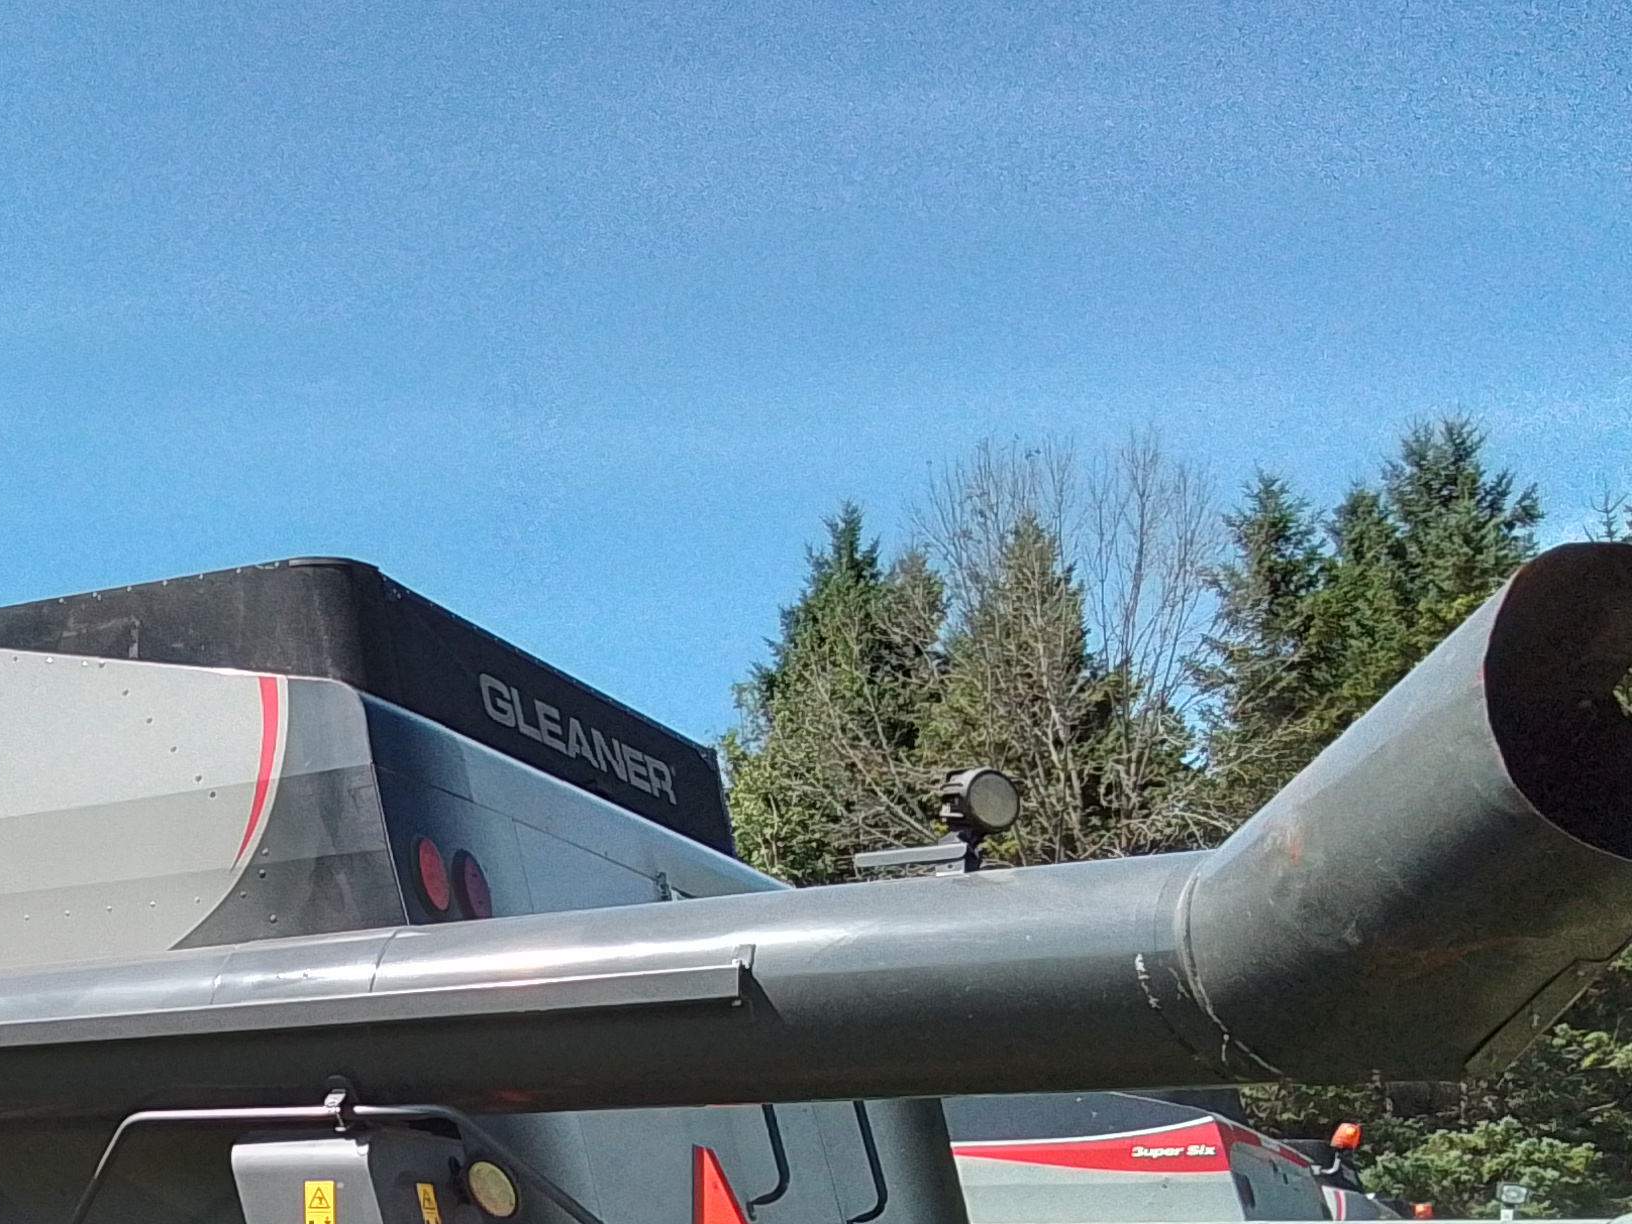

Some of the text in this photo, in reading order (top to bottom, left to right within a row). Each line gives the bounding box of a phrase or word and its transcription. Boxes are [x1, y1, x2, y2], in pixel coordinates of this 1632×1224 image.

[478, 672, 678, 806] GLEANER
[1130, 1143, 1217, 1160] Super Six
